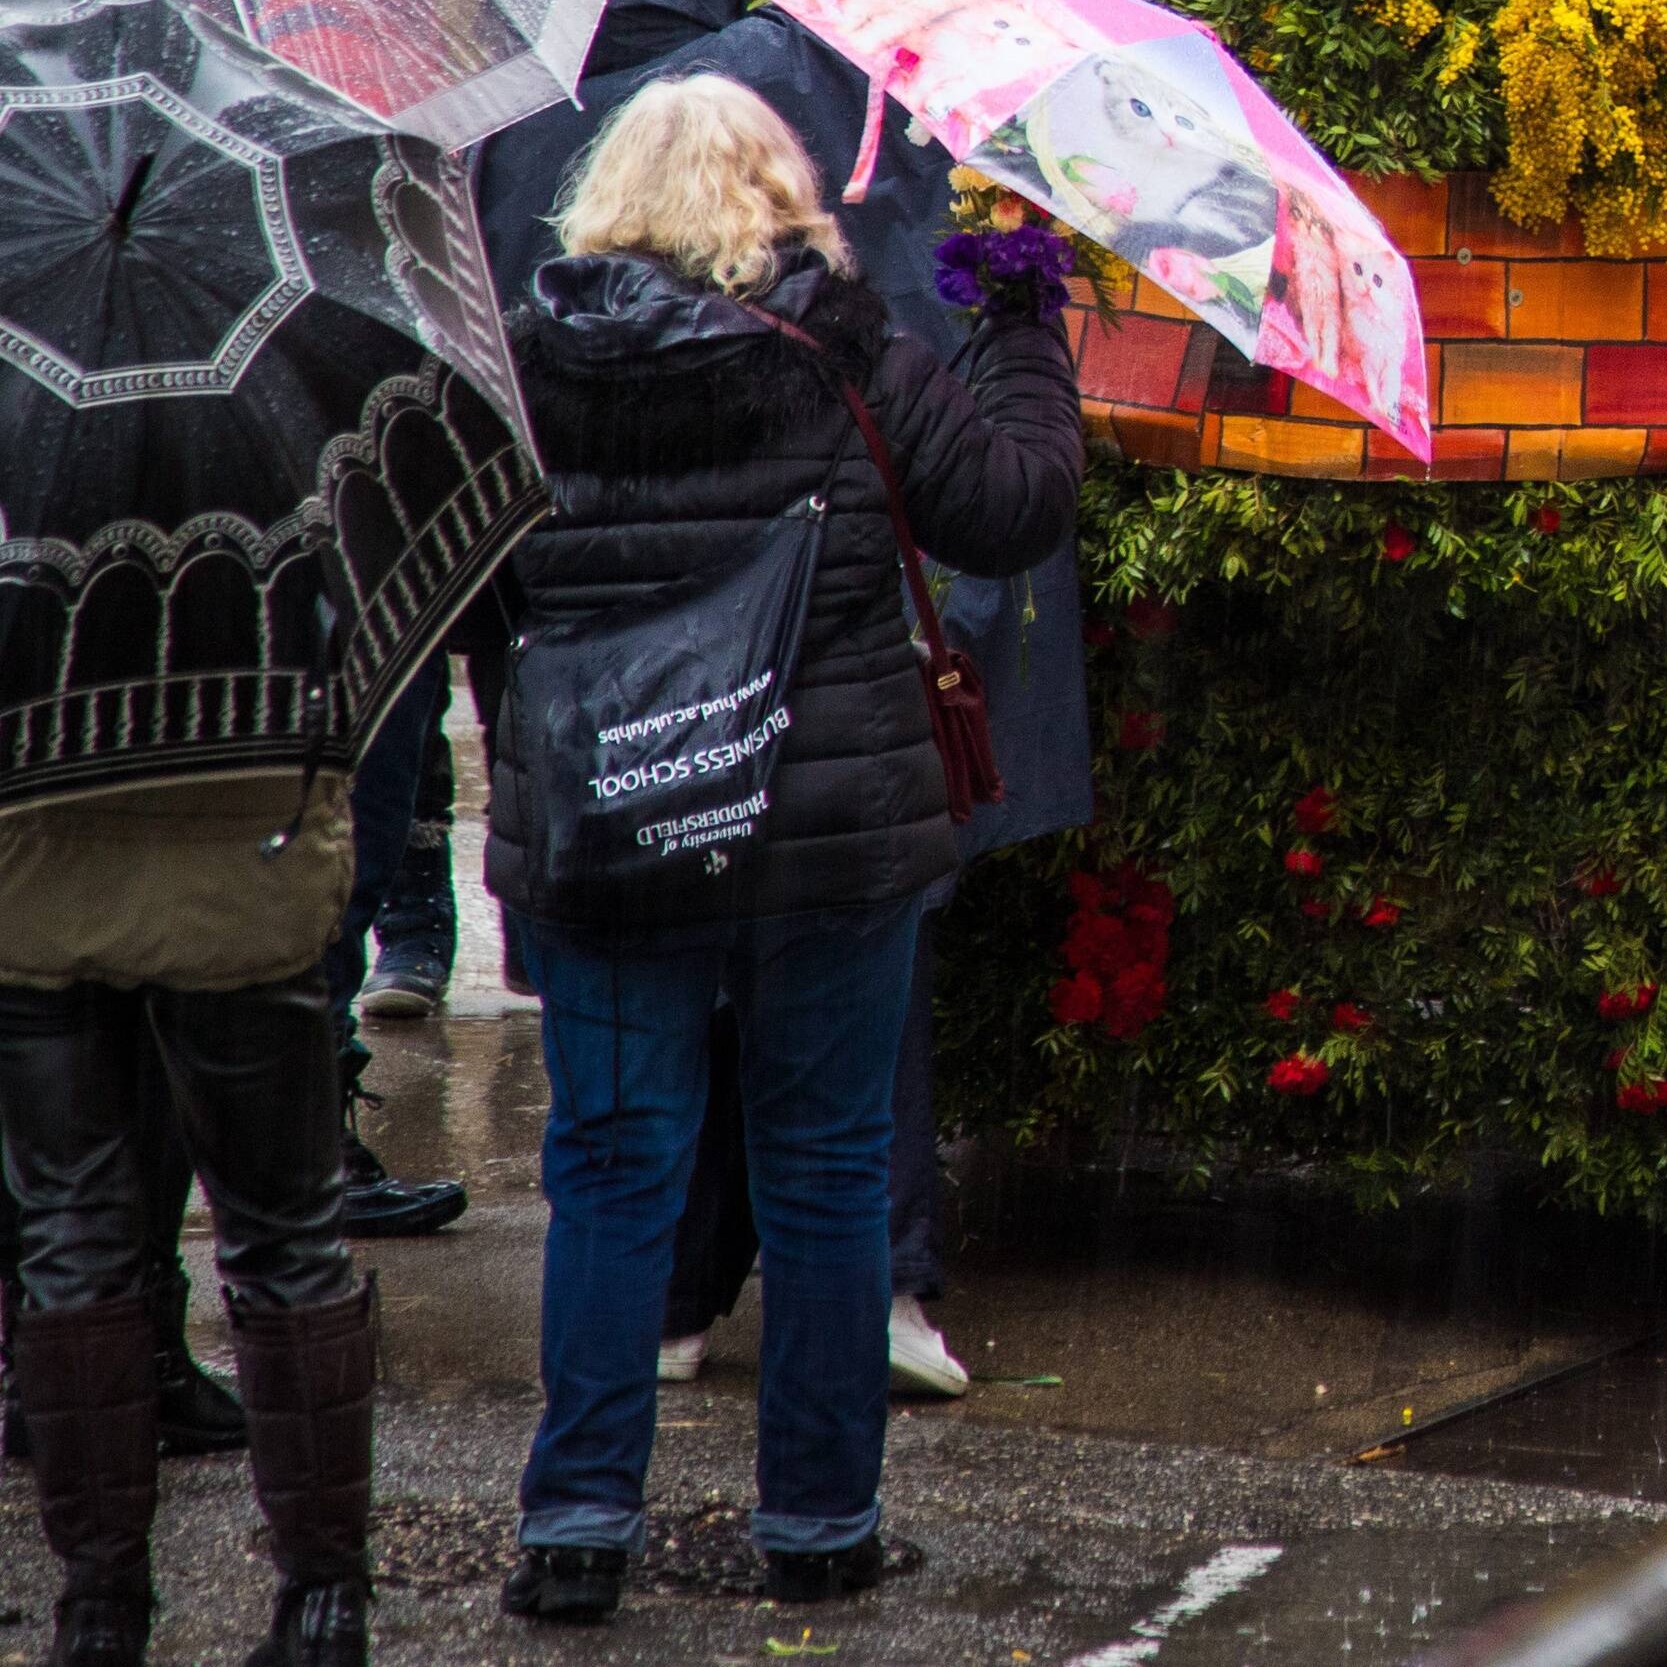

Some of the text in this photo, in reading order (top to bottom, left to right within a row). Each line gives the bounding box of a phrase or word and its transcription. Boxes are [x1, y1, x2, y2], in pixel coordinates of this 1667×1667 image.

[598, 669, 772, 745] www.hud.ac.uk/uhbs
[588, 706, 791, 800] BUSINESS SCHOOL
[636, 789, 769, 846] HUDDERSFIELD
[661, 821, 753, 856] University of
